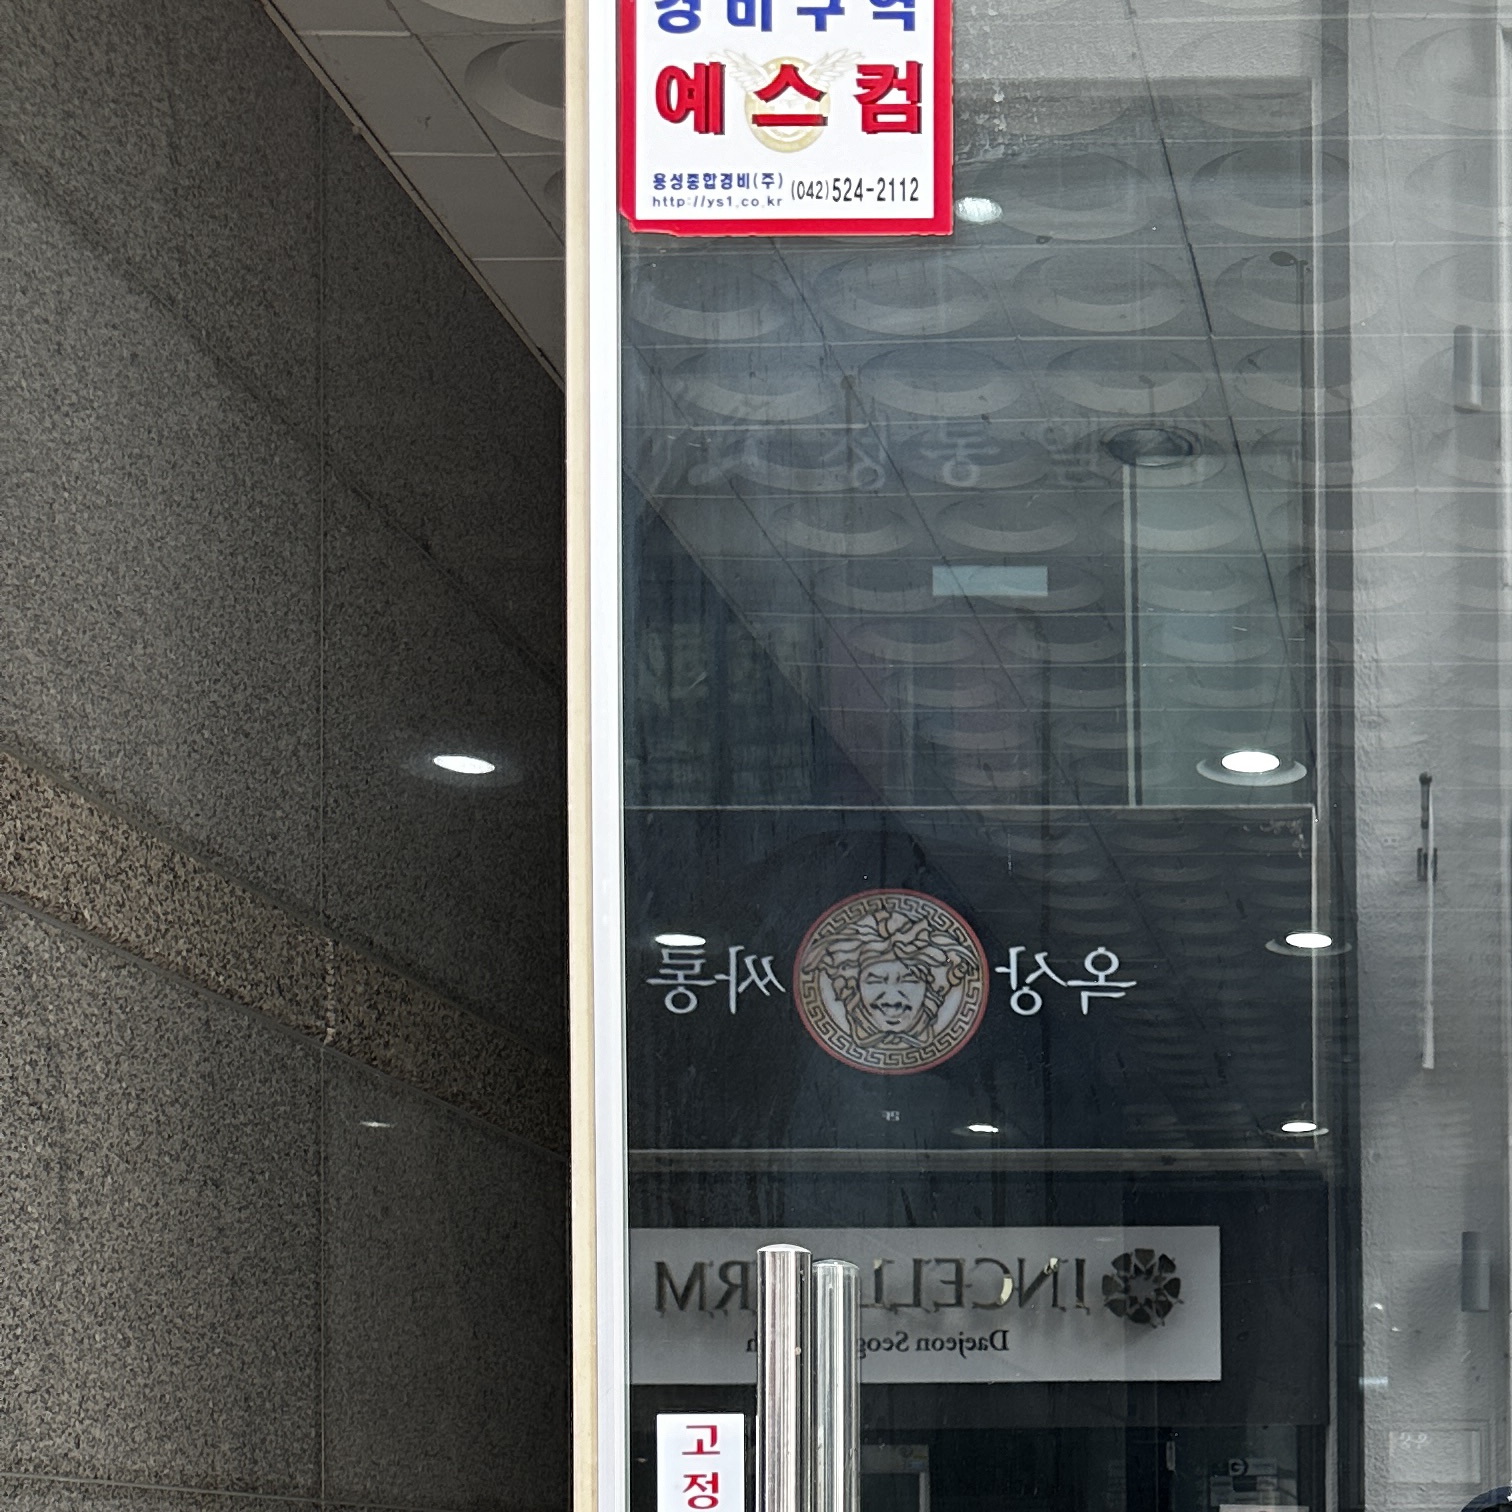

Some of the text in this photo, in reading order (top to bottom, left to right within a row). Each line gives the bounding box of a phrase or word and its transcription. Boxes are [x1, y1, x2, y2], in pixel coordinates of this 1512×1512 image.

[655, 61, 922, 135] 예스컴
[652, 173, 783, 191] 용성종합경비(주)
[652, 195, 783, 208] http://ys1.co.kr
